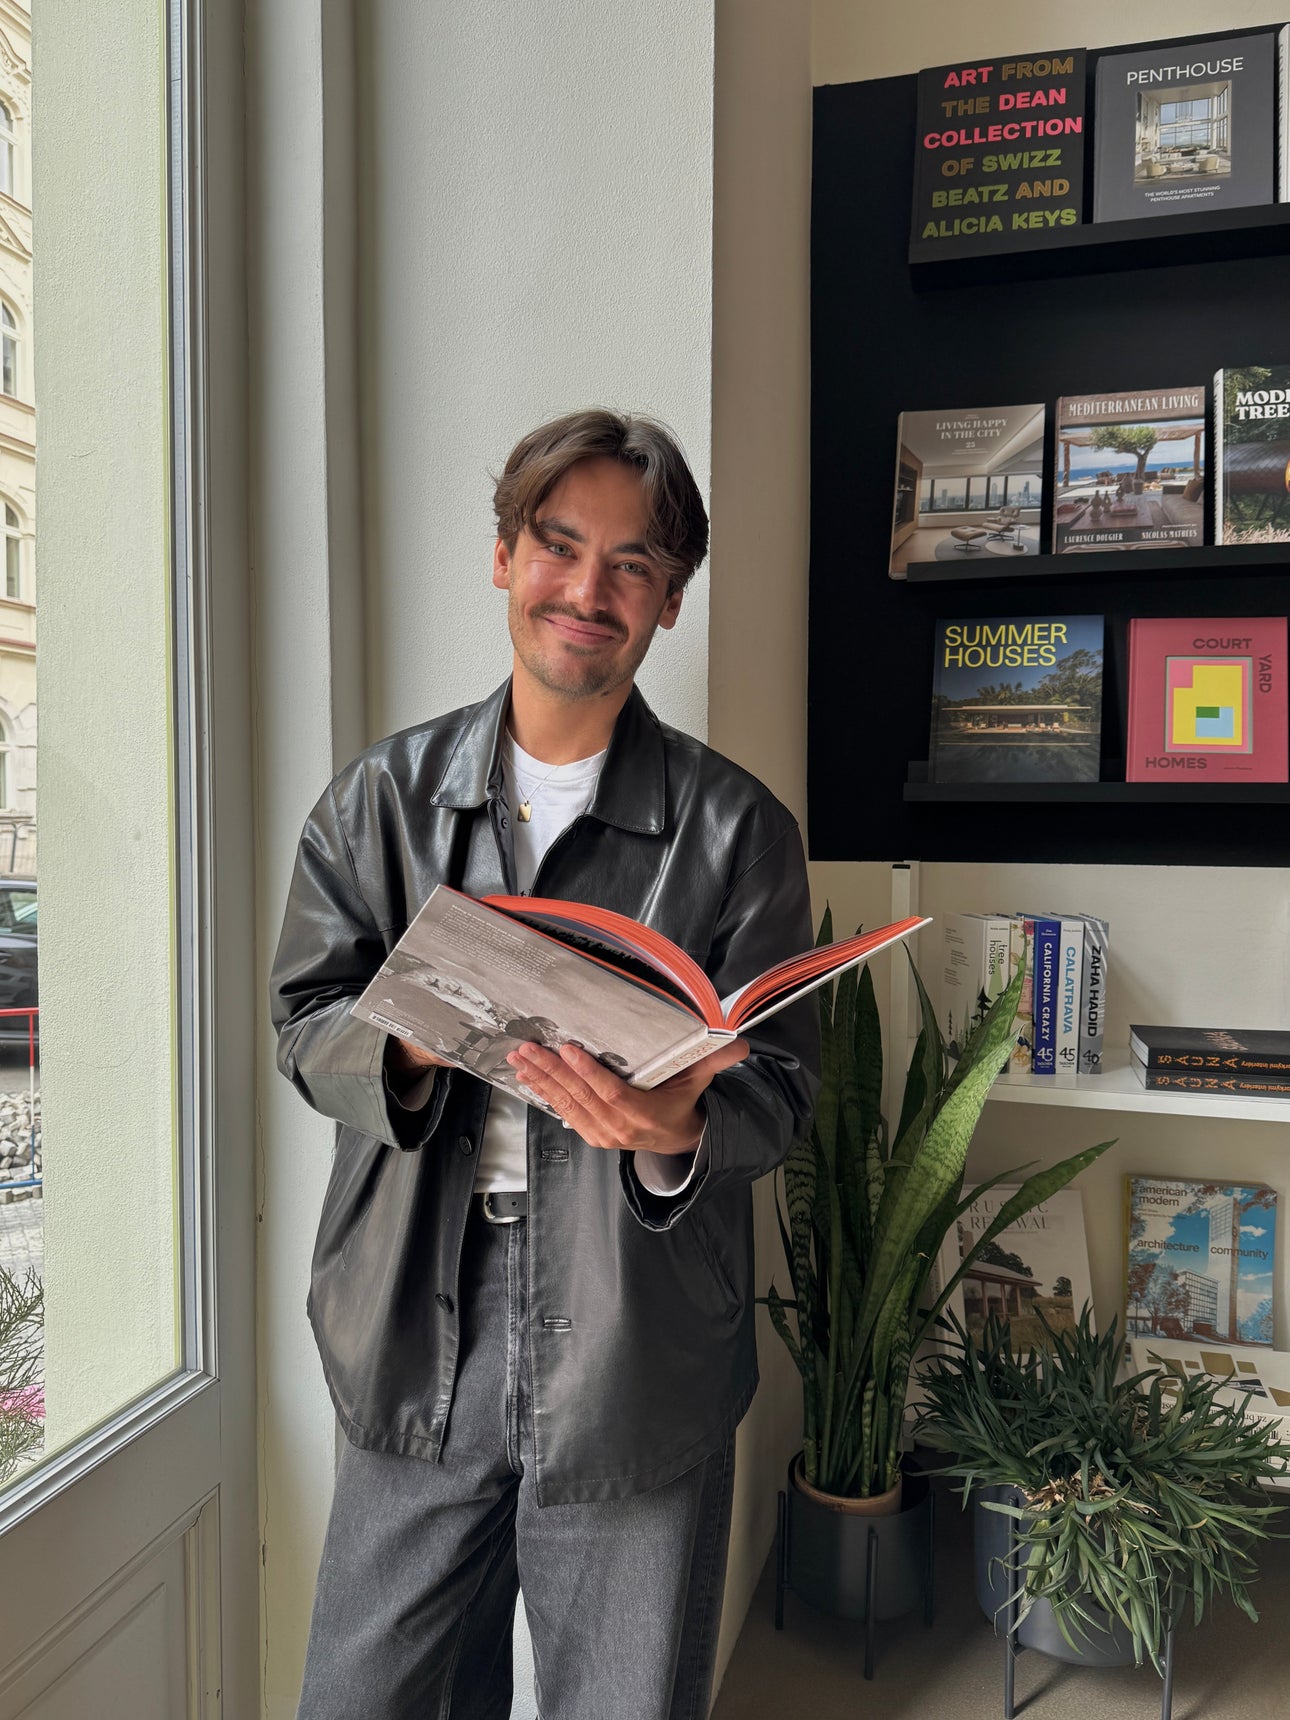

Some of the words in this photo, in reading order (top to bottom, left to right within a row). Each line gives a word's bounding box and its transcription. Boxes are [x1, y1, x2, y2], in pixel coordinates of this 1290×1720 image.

[944, 66, 993, 88] ART
[1001, 56, 1074, 81] FROM
[1126, 57, 1244, 86] PENTHOUSE
[941, 96, 991, 118] THE
[998, 87, 1067, 111] DEAN
[923, 116, 1083, 150] COLLECTION
[941, 157, 974, 177] OF
[981, 148, 1062, 173] SWIZZ
[931, 184, 1009, 208] BEATZ
[1015, 178, 1071, 200] AND
[922, 215, 1003, 239] ALICIA
[1011, 208, 1077, 231] KEYS
[1069, 396, 1159, 417] MEDITERRANEAN
[1162, 394, 1199, 410] LIVING
[1235, 404, 1290, 421] TREE
[936, 420, 971, 431] LIVING
[973, 418, 1009, 429] HAPPY
[941, 431, 952, 440] IN
[954, 429, 975, 440] THE
[977, 428, 1002, 438] CITY
[1141, 531, 1168, 541] NICOLAS
[944, 623, 1068, 647] SUMMER
[1192, 637, 1253, 650] COURT
[944, 645, 1057, 668] HOUSES
[1258, 654, 1272, 693] YARD
[1145, 756, 1207, 769] HOMES
[988, 940, 1002, 975] houses
[998, 944, 1008, 965] tree
[1089, 945, 1102, 987] ZAHA
[1042, 942, 1053, 1003] CALIFORNIA
[1063, 946, 1077, 1034] CALATRAVA
[1041, 1006, 1052, 1041] CRAZY
[1087, 989, 1100, 1037] HADID
[1036, 1047, 1053, 1062] 45
[1059, 1047, 1076, 1062] 45
[1082, 1050, 1100, 1065] 40
[1138, 1196, 1180, 1207] modern
[1139, 1186, 1187, 1197] american
[1136, 1237, 1200, 1254] architecture
[1210, 1244, 1269, 1260] community
